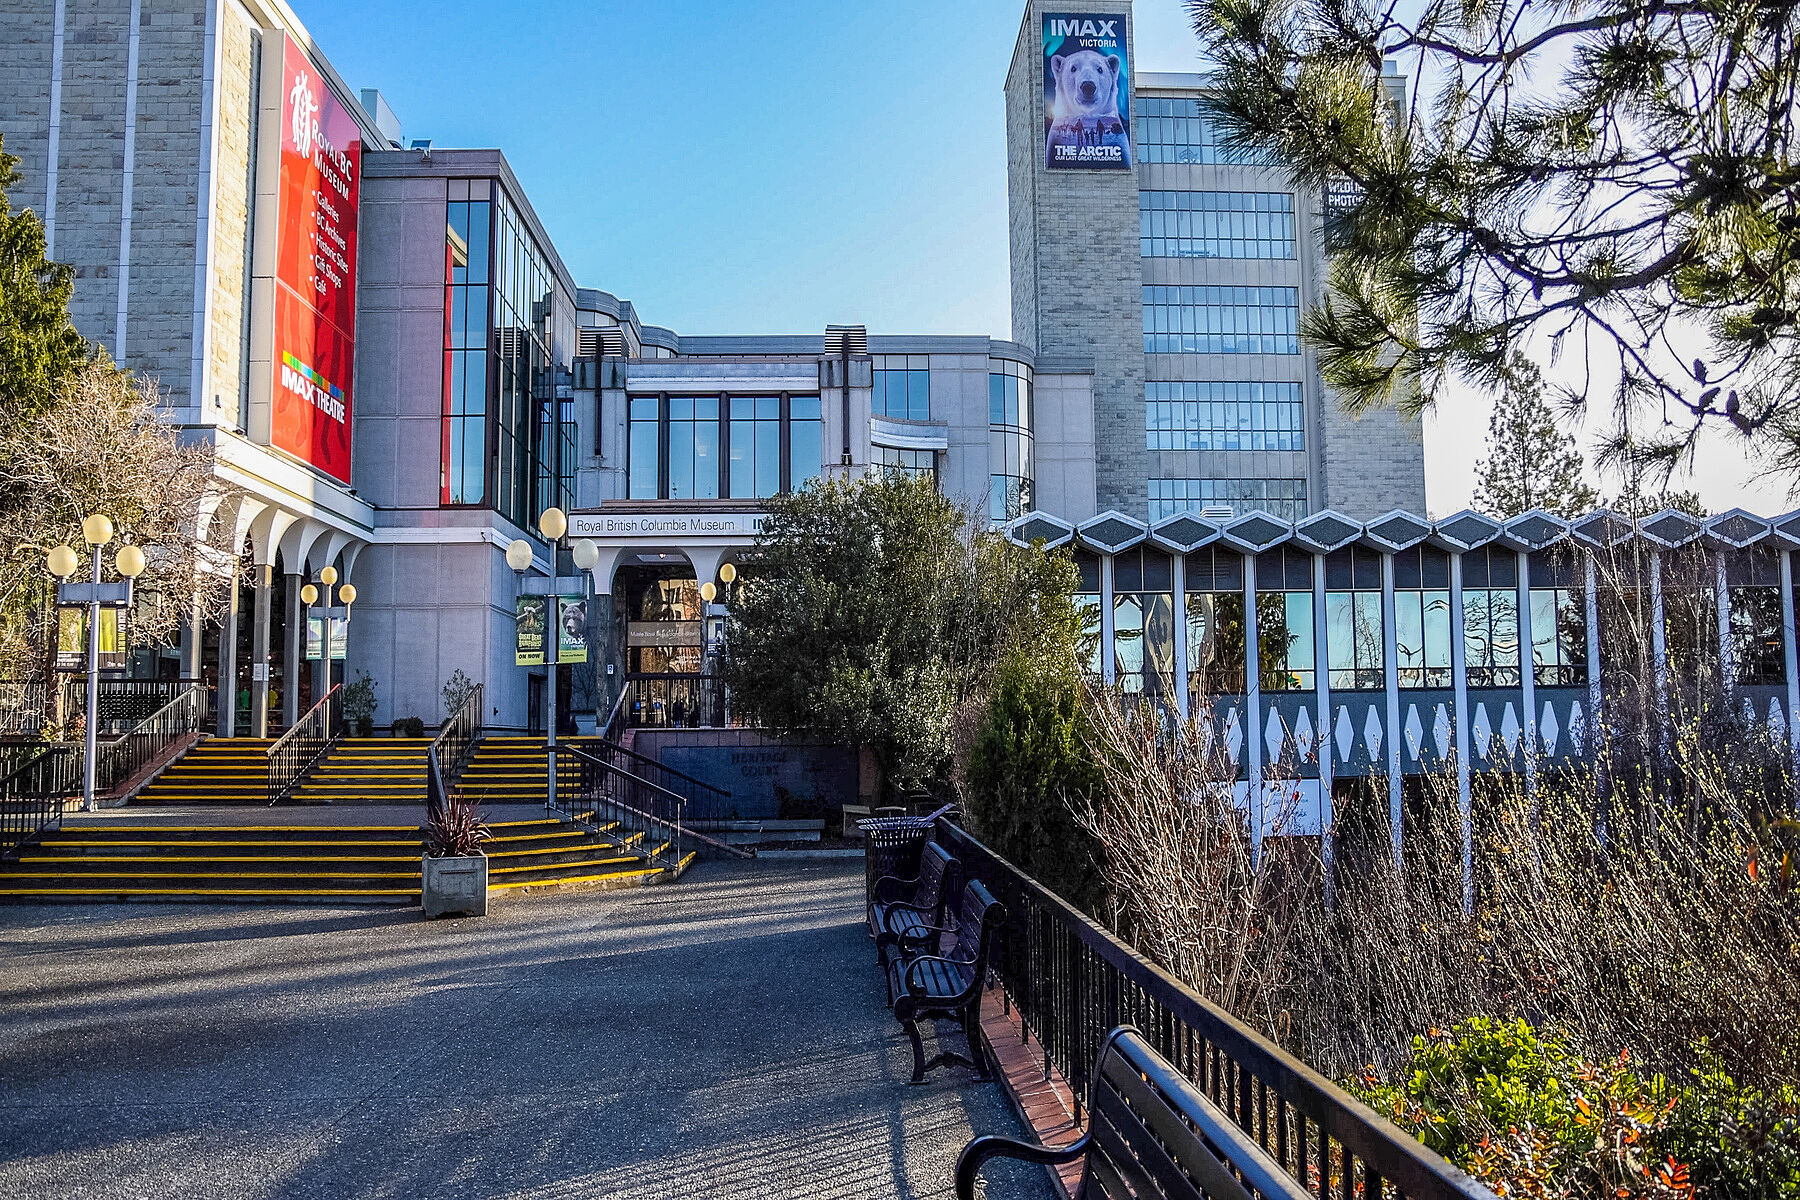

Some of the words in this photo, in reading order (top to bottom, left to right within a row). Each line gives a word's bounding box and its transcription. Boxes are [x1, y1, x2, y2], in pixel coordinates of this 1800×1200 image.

[1050, 19, 1117, 37] IMAX
[1079, 39, 1117, 48] VICTORIA
[312, 118, 339, 168] ROYAL
[340, 151, 353, 182] BC
[1054, 145, 1077, 155] THE
[1079, 145, 1122, 156] ARCTIC
[314, 147, 349, 201] MUSEUM
[316, 191, 340, 224] Galleries
[316, 211, 325, 230] BC
[325, 220, 346, 251] Archives
[315, 232, 337, 263] Historic
[336, 252, 349, 275] Sites
[314, 275, 327, 296] Café
[315, 254, 326, 275] Gift
[325, 264, 342, 289] Shops
[281, 364, 315, 405] IMAX
[316, 387, 345, 425] THEATRE
[576, 519, 604, 534] Royal
[607, 519, 638, 532] British
[640, 518, 687, 532] Columbia
[690, 518, 735, 531] Museum
[560, 637, 585, 645] IMAX
